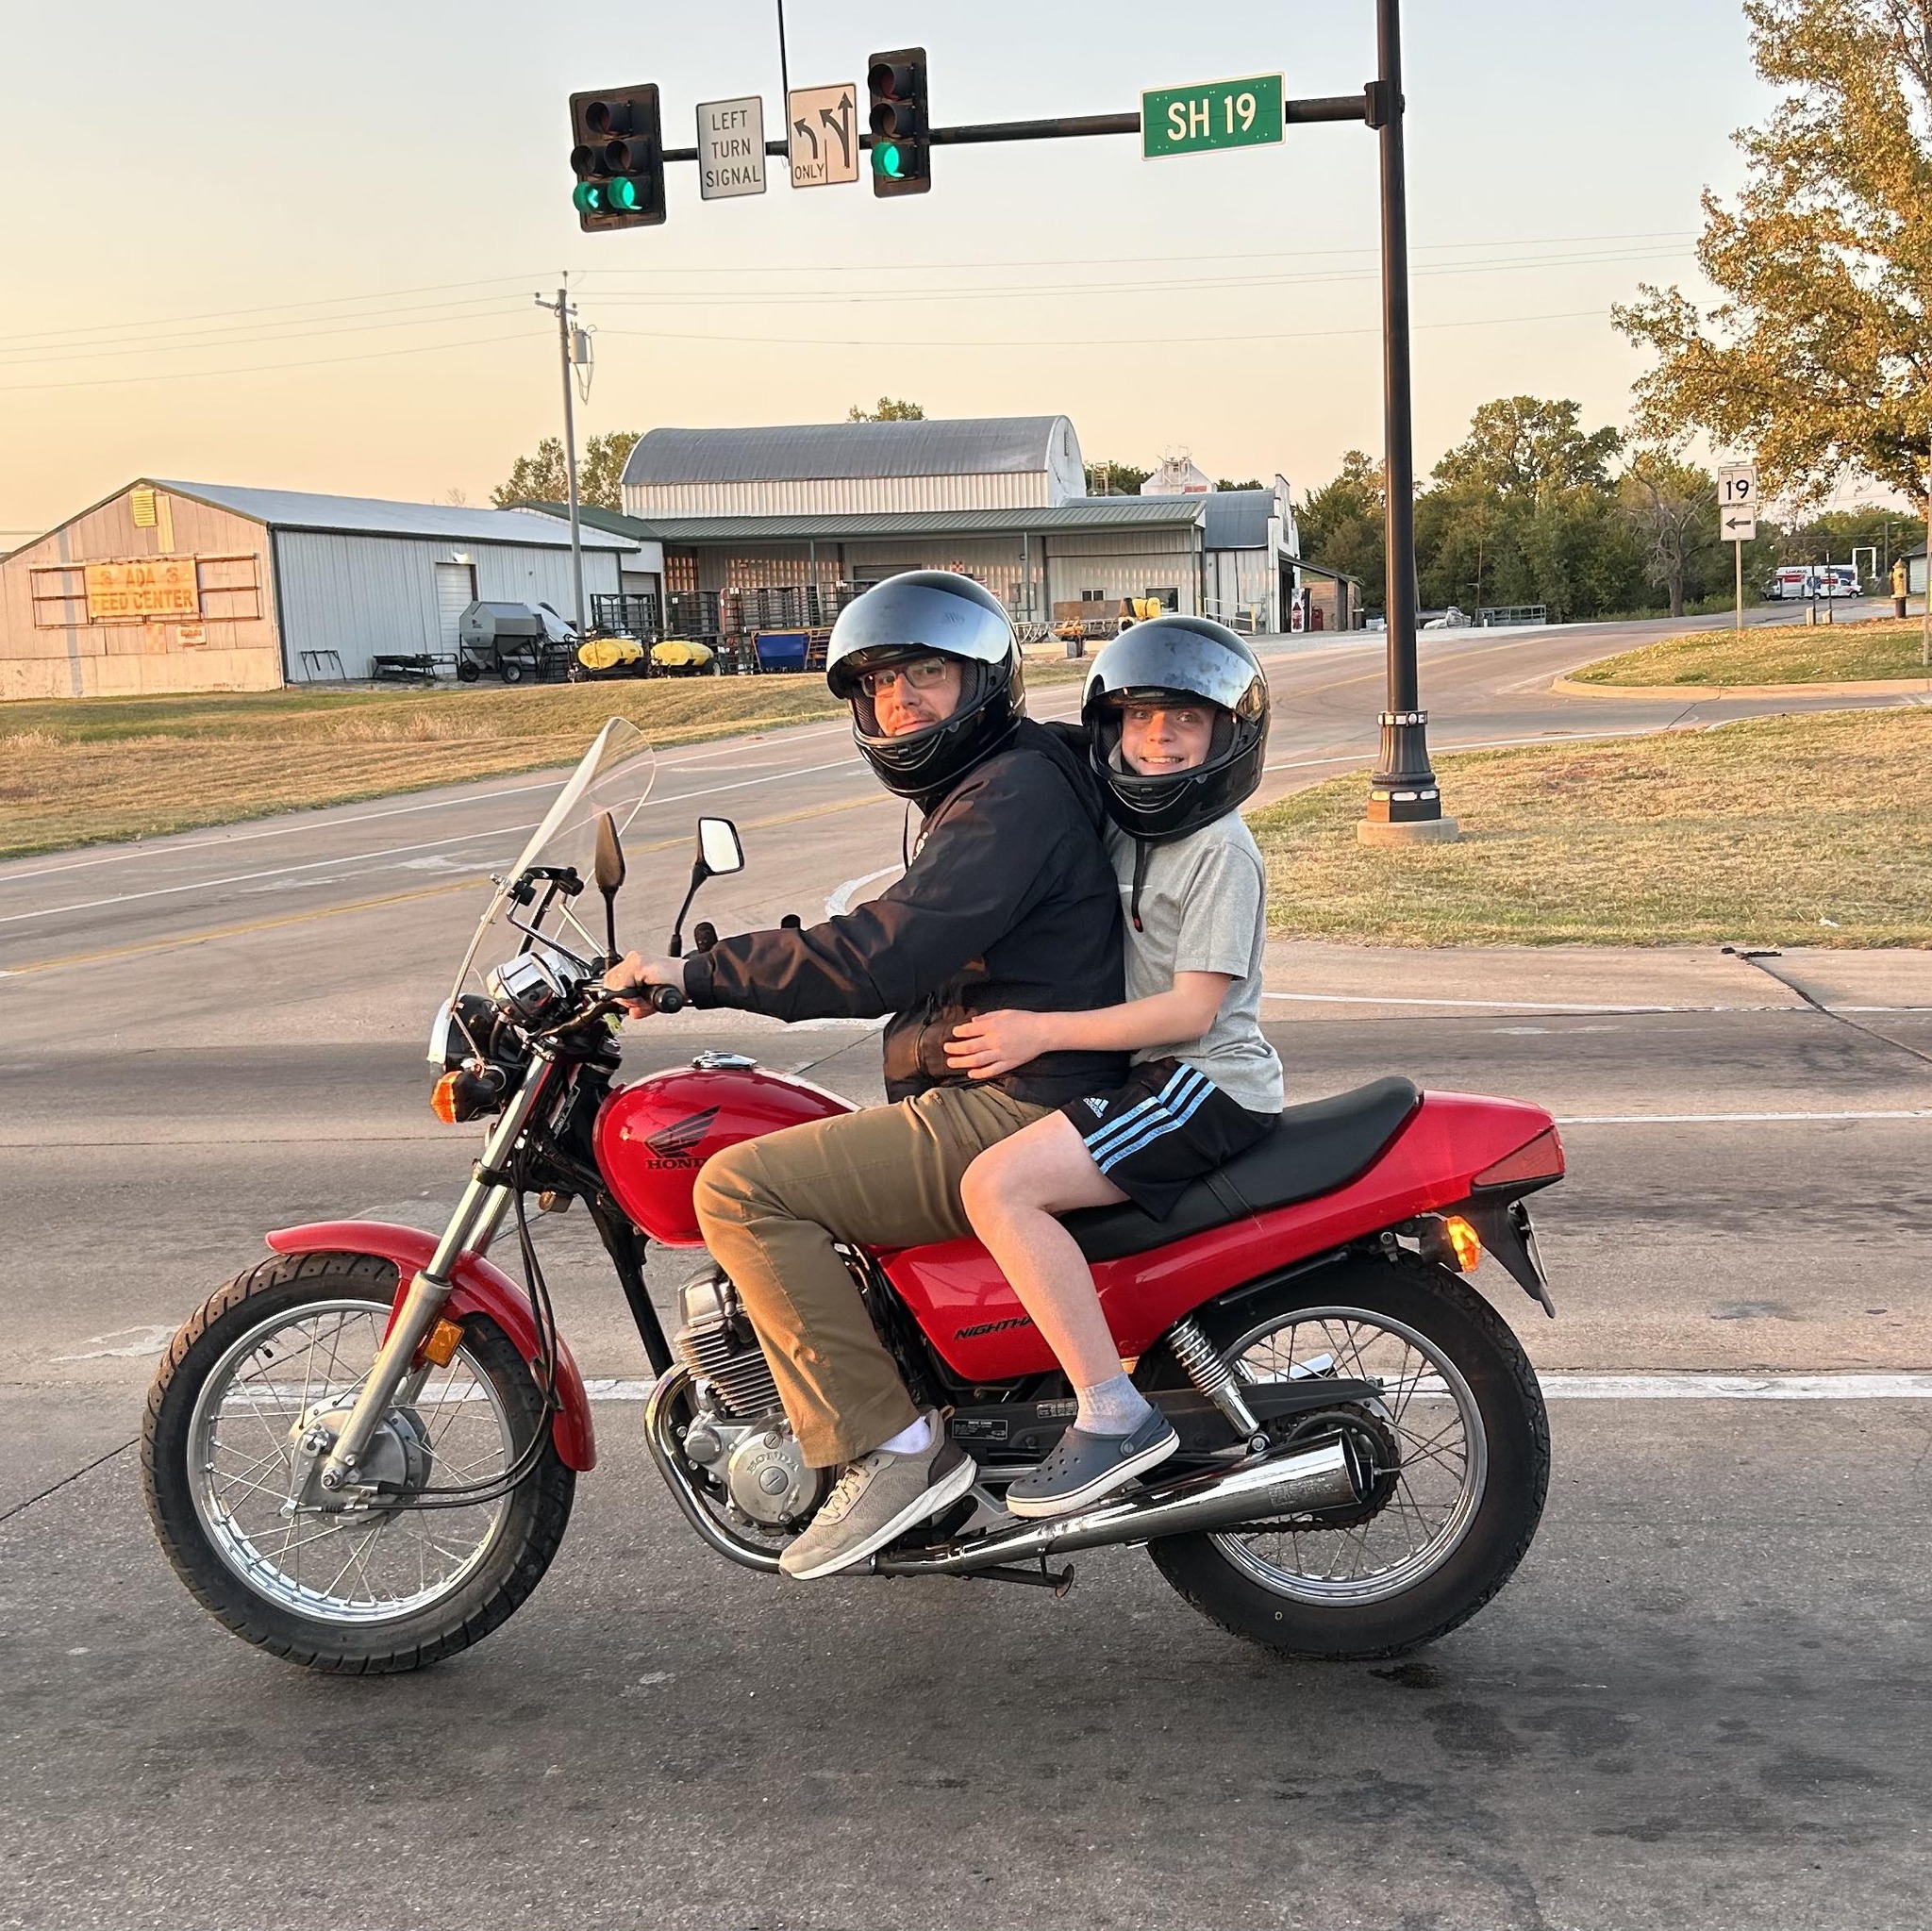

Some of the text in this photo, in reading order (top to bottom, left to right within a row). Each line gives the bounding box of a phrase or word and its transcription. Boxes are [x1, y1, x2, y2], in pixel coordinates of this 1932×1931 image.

[712, 109, 748, 131] LEFT
[1167, 92, 1257, 141] SH 19
[711, 138, 751, 159] TURN
[706, 165, 761, 188] SIGNAL
[794, 163, 824, 180] ONLY
[1726, 479, 1749, 500] 19
[126, 568, 155, 587] ADA
[92, 589, 193, 611] FEED CENTER
[645, 1157, 708, 1170] HOND
